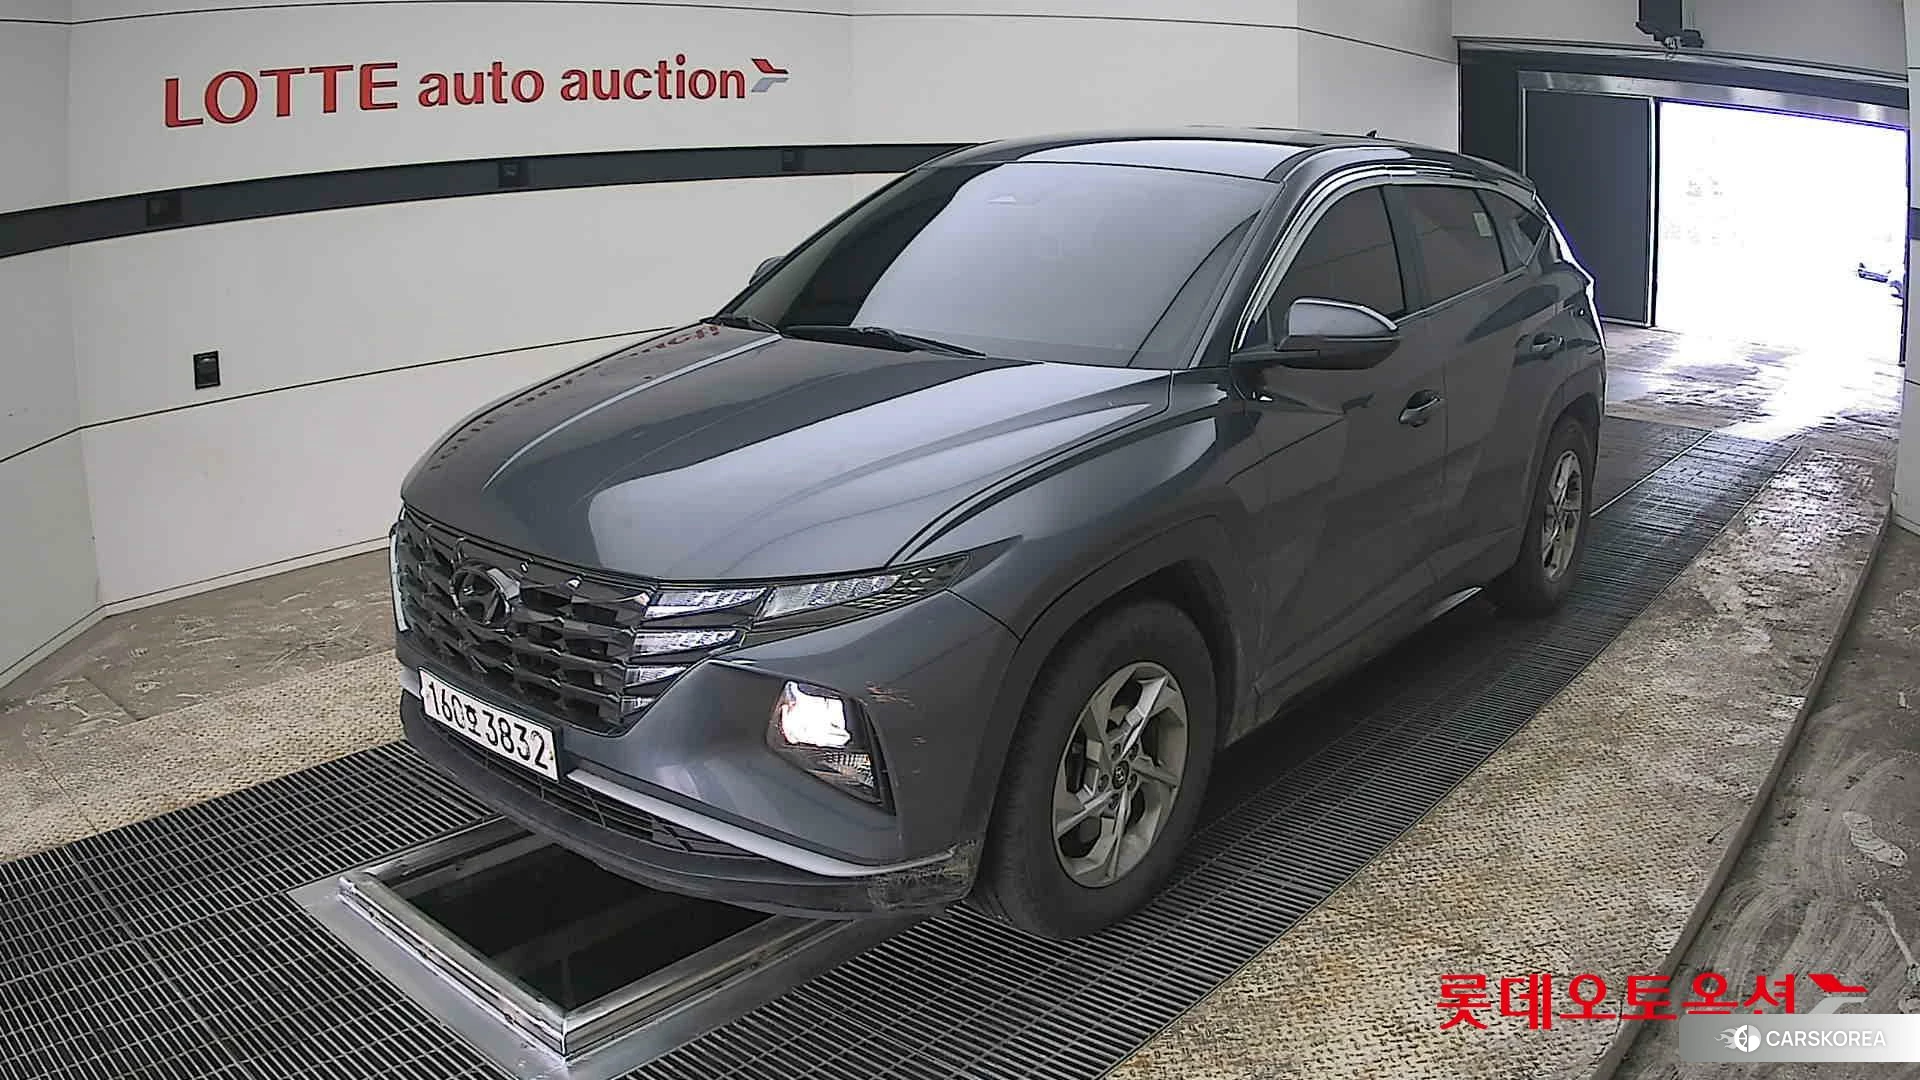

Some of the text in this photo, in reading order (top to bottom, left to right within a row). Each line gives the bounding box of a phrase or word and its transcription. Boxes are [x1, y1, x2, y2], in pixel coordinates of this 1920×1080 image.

[165, 54, 746, 128] LOTTE auto auction
